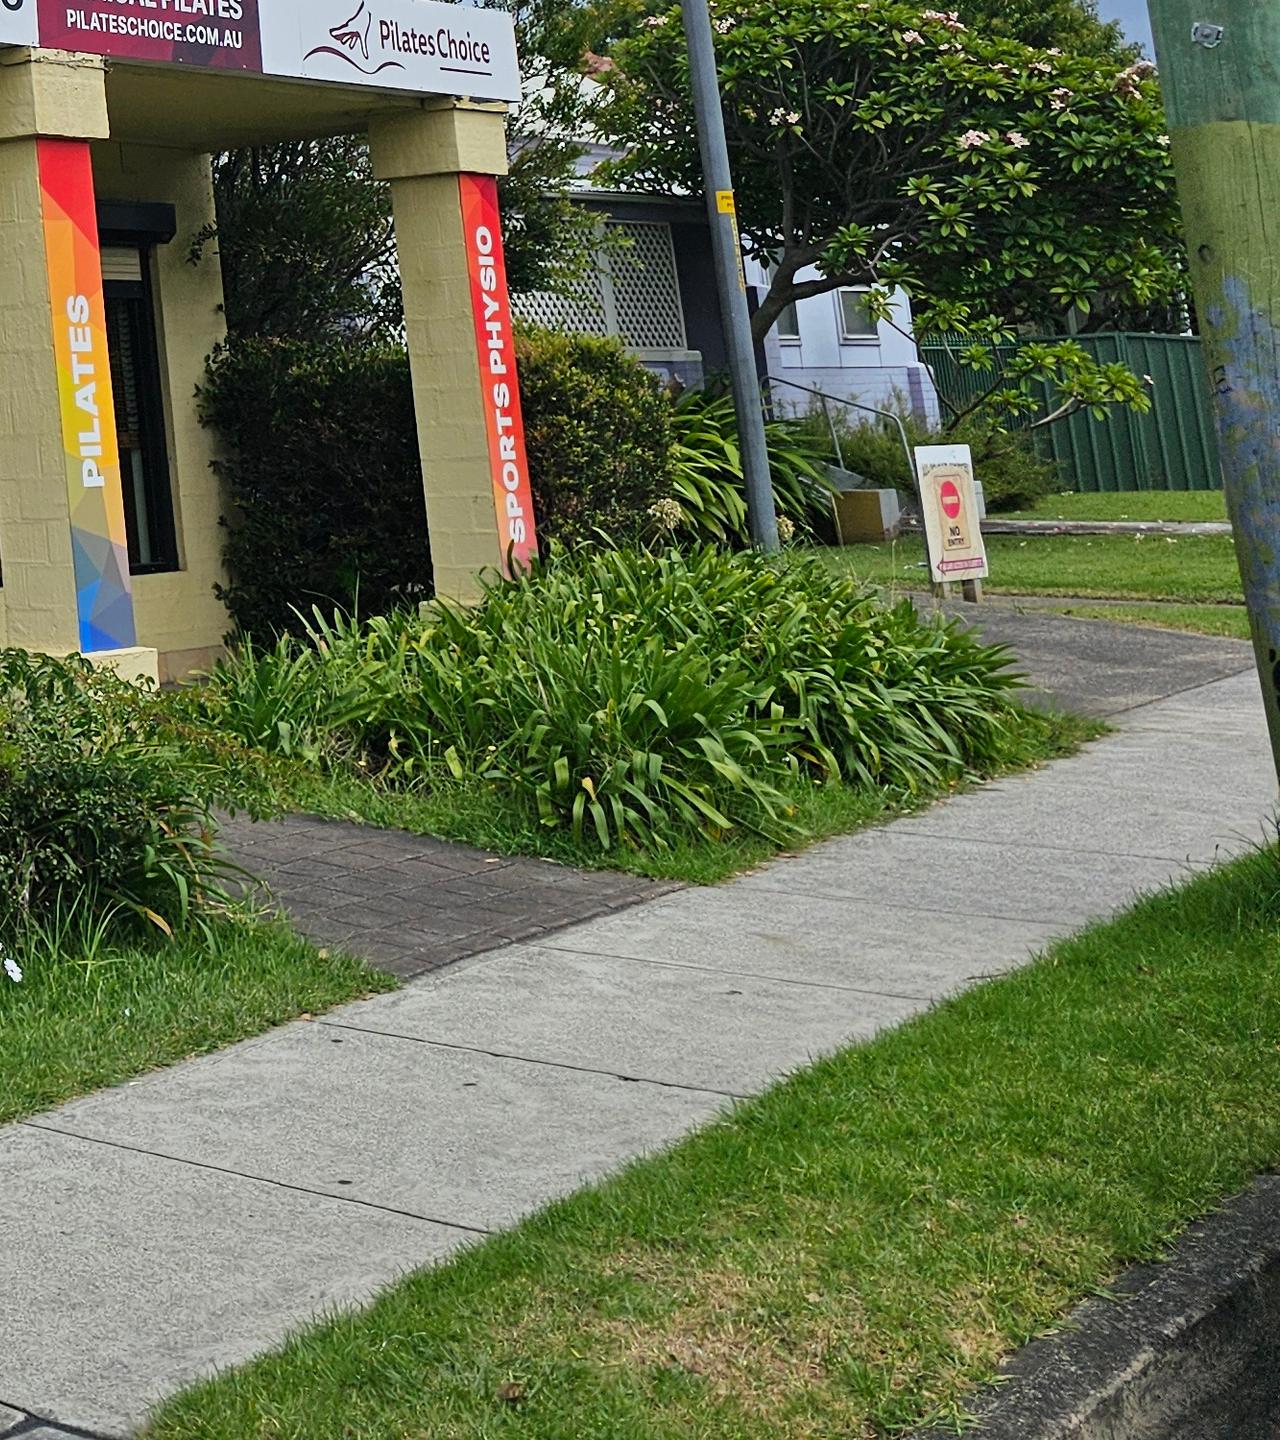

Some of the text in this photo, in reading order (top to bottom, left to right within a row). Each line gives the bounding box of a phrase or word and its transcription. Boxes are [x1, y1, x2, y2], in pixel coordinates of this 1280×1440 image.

[66, 8, 243, 50] PILATESCHOICE.COM.AU
[379, 19, 491, 65] PilatesChoice
[66, 294, 105, 488] PILATES
[475, 225, 526, 544] SPORTS PHYSIO
[949, 526, 960, 536] NO
